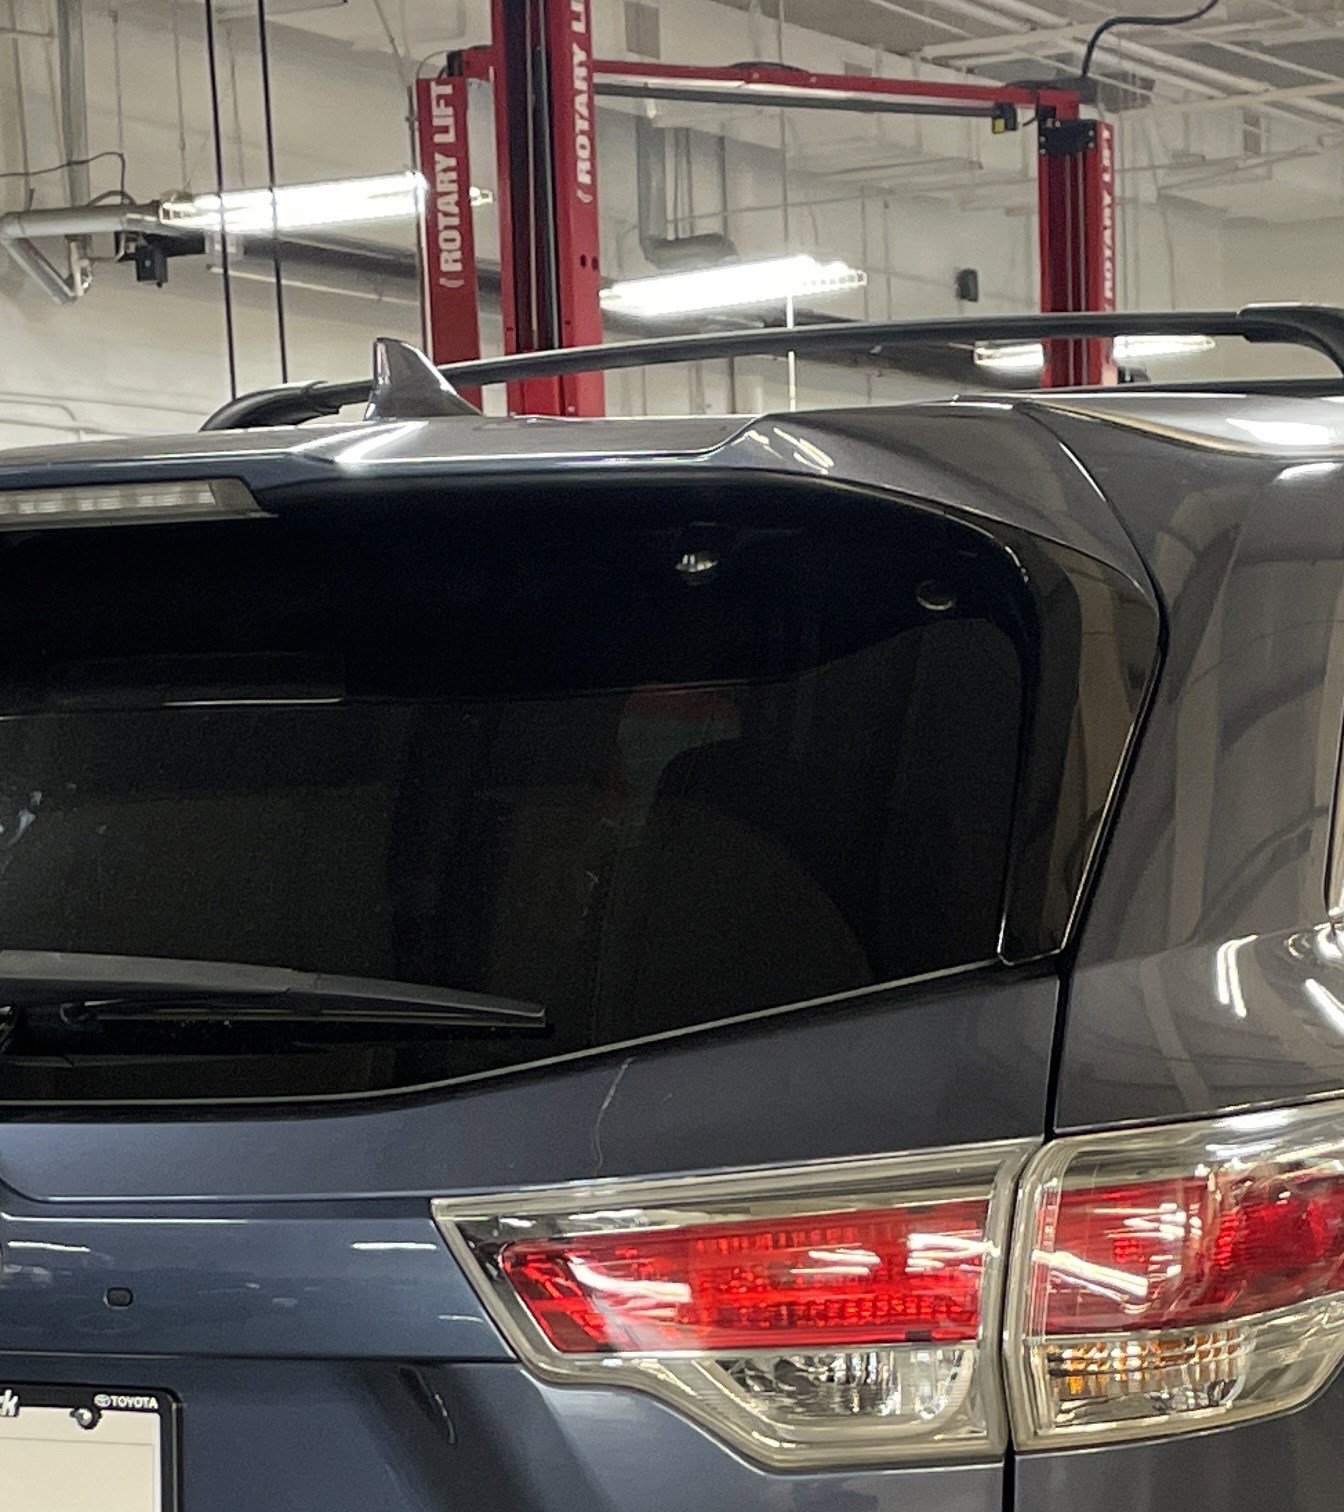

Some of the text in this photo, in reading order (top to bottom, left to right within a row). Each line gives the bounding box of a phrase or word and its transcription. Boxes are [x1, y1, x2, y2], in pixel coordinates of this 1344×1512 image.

[430, 81, 464, 273] ROTARY LIFT
[570, 0, 593, 185] ROTARY LI
[110, 1395, 159, 1410] TOYOTA
